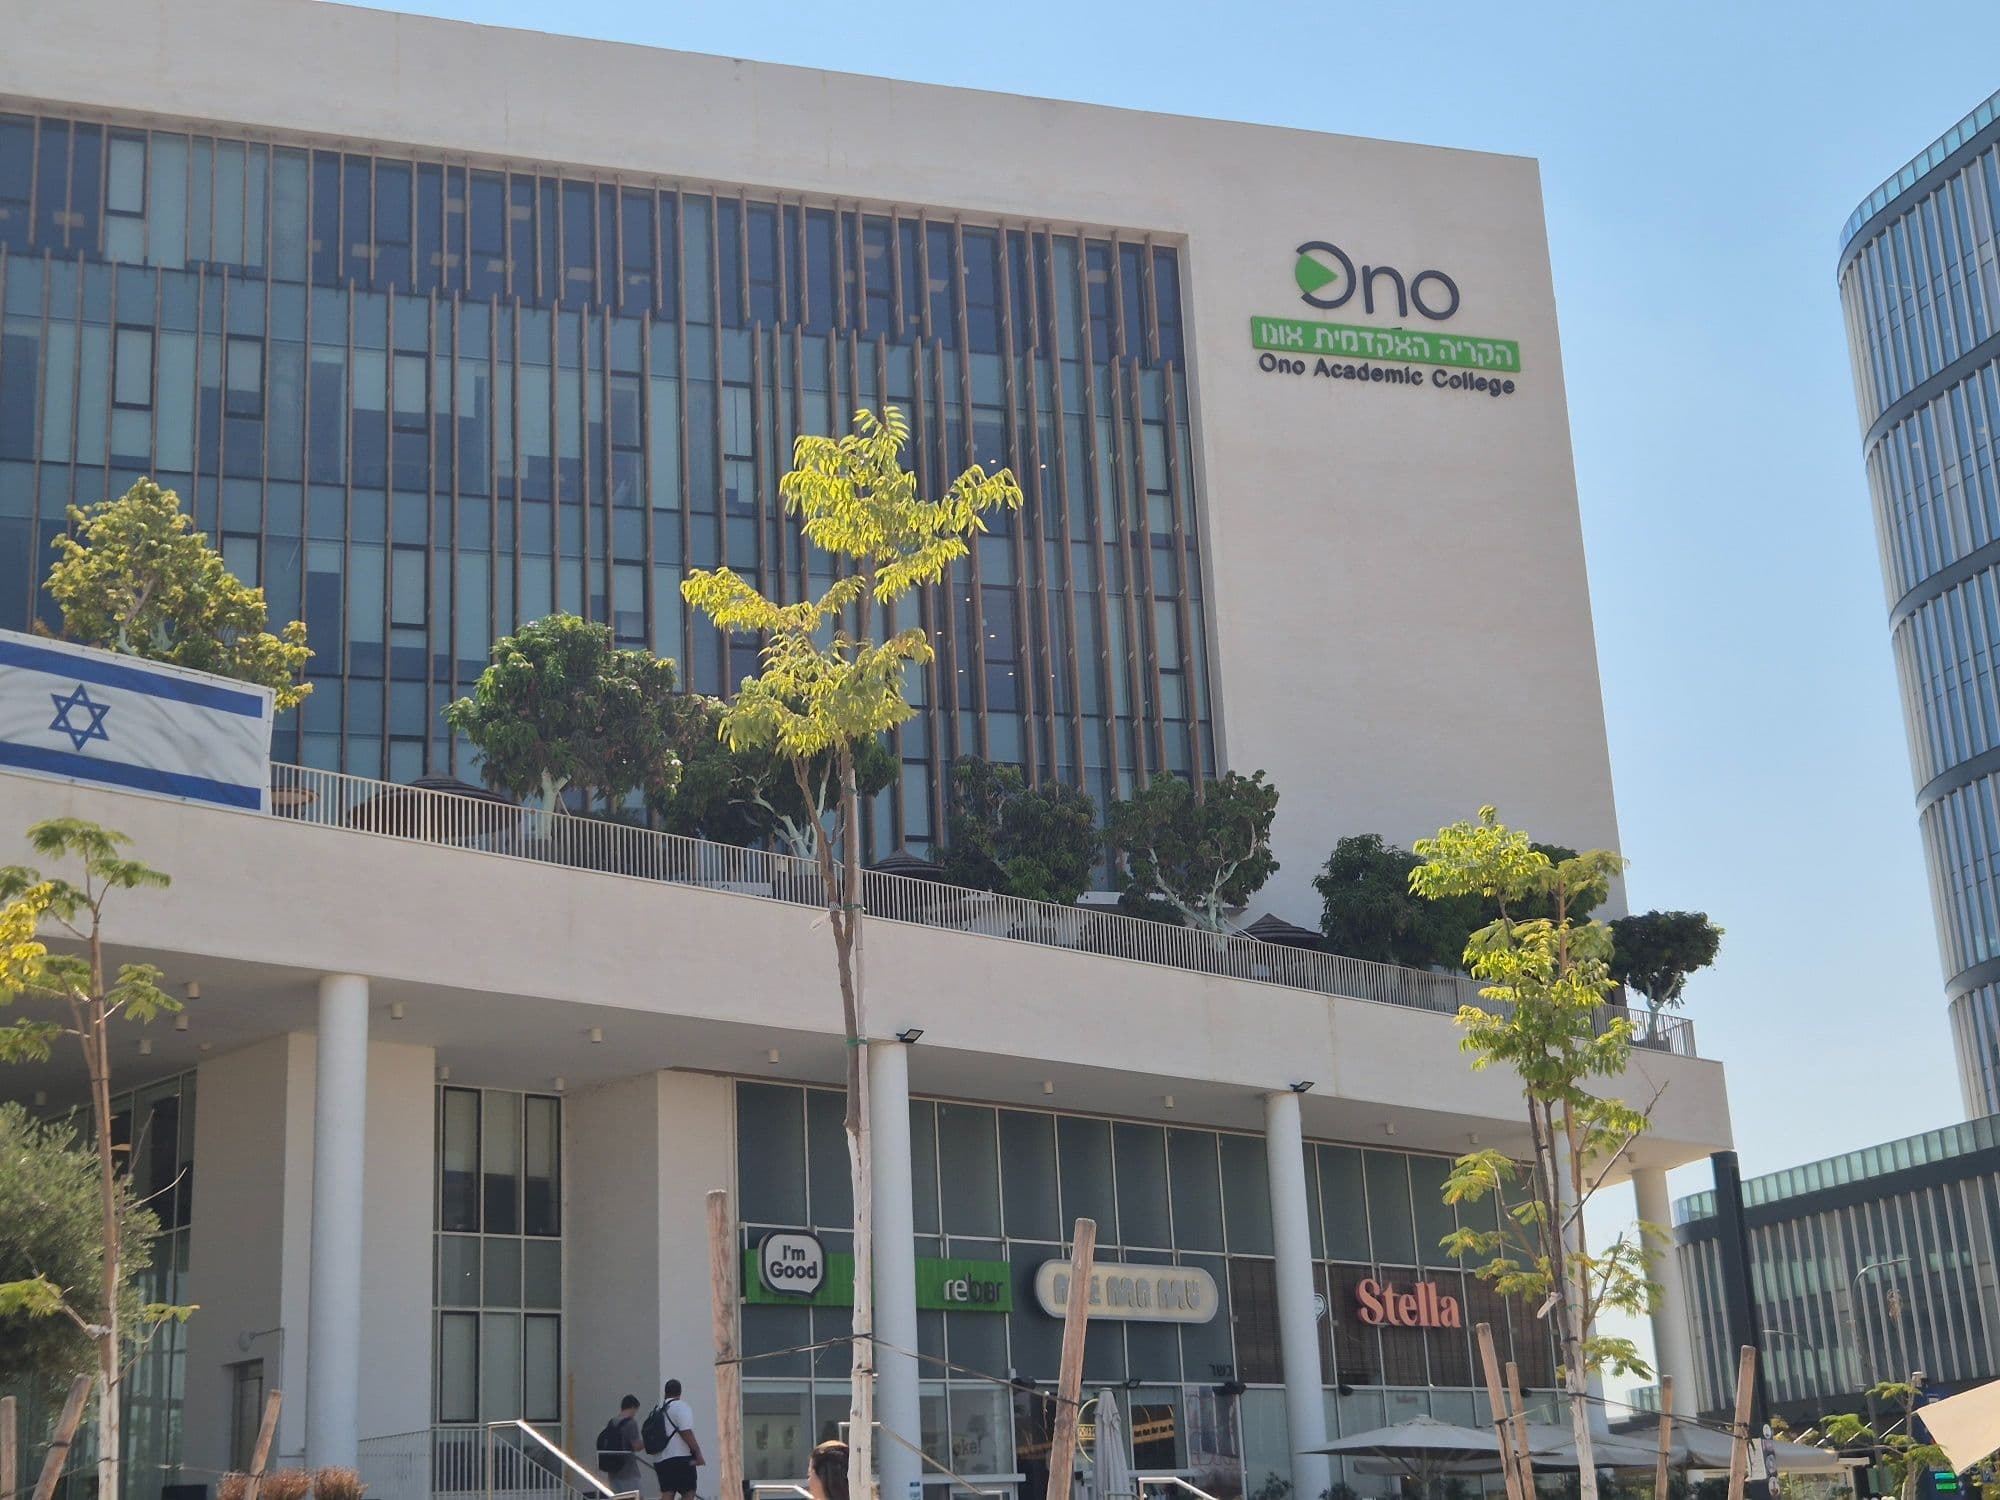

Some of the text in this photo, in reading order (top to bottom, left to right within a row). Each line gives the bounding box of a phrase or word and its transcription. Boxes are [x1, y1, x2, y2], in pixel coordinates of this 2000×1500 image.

[1294, 240, 1460, 321] Ono
[1261, 322, 1514, 367] הקריה האקדמית אונו
[1259, 352, 1516, 398] Ono Academic College
[770, 1260, 818, 1280] Good
[783, 1244, 806, 1261] I'm
[943, 1271, 1004, 1304] rebar
[1356, 1277, 1462, 1329] Stella
